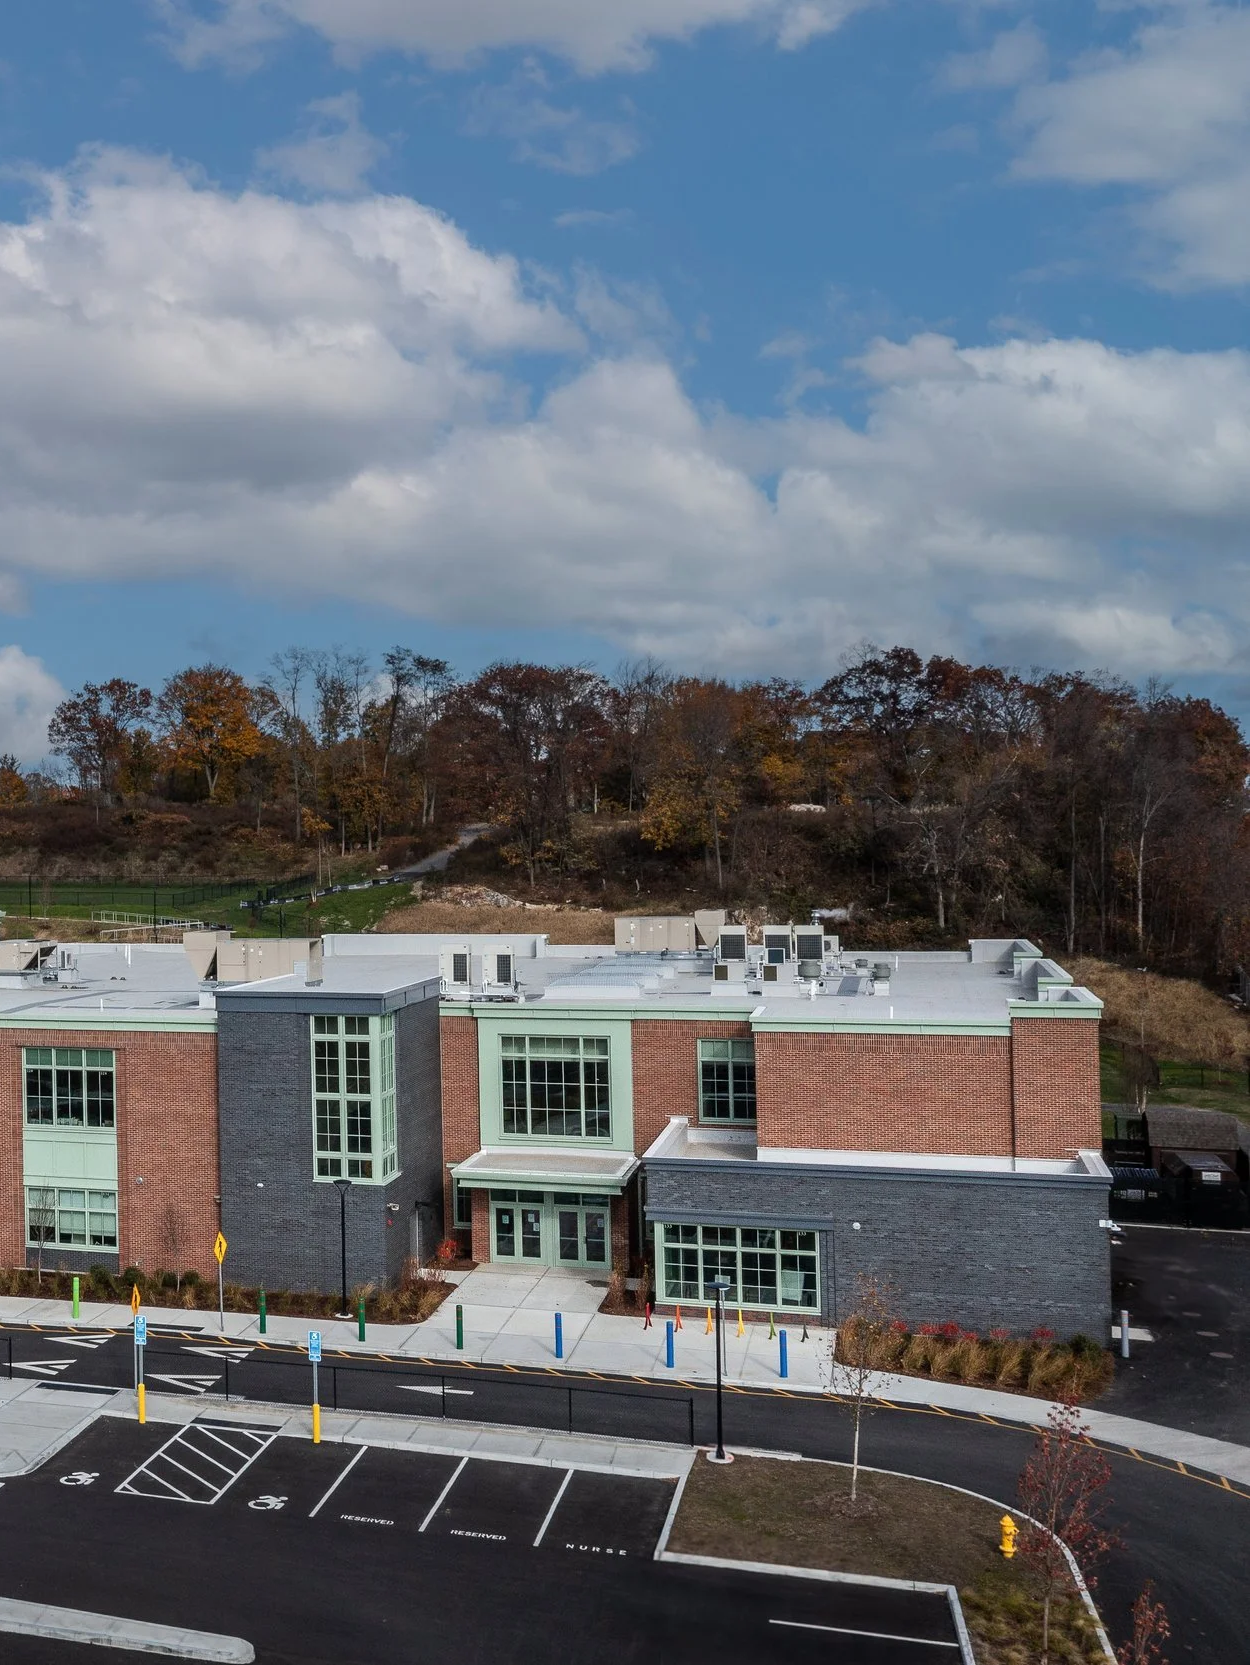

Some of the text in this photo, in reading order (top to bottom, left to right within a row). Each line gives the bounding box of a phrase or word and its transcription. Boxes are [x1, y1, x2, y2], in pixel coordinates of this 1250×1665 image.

[340, 1514, 395, 1525] RESERVED
[450, 1529, 507, 1541] RESERVED
[565, 1543, 628, 1556] NURSE
